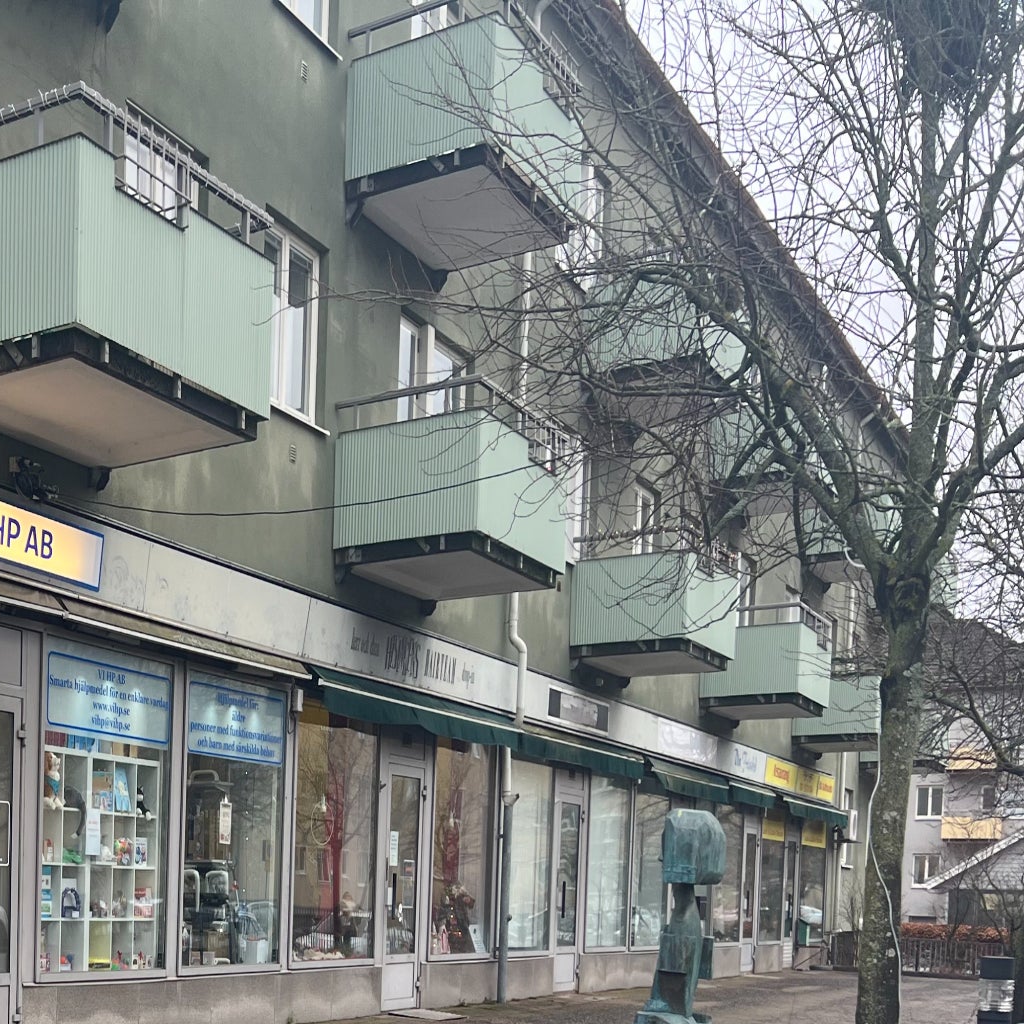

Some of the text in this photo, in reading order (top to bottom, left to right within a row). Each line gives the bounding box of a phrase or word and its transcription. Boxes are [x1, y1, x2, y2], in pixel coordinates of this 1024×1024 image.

[24, 525, 54, 560] AB
[49, 674, 73, 689] Smarta
[74, 678, 109, 697] hjälpmedel
[109, 686, 118, 698] för
[92, 701, 130, 717] www.vihp.se
[91, 715, 131, 732] vihp@vihp.se
